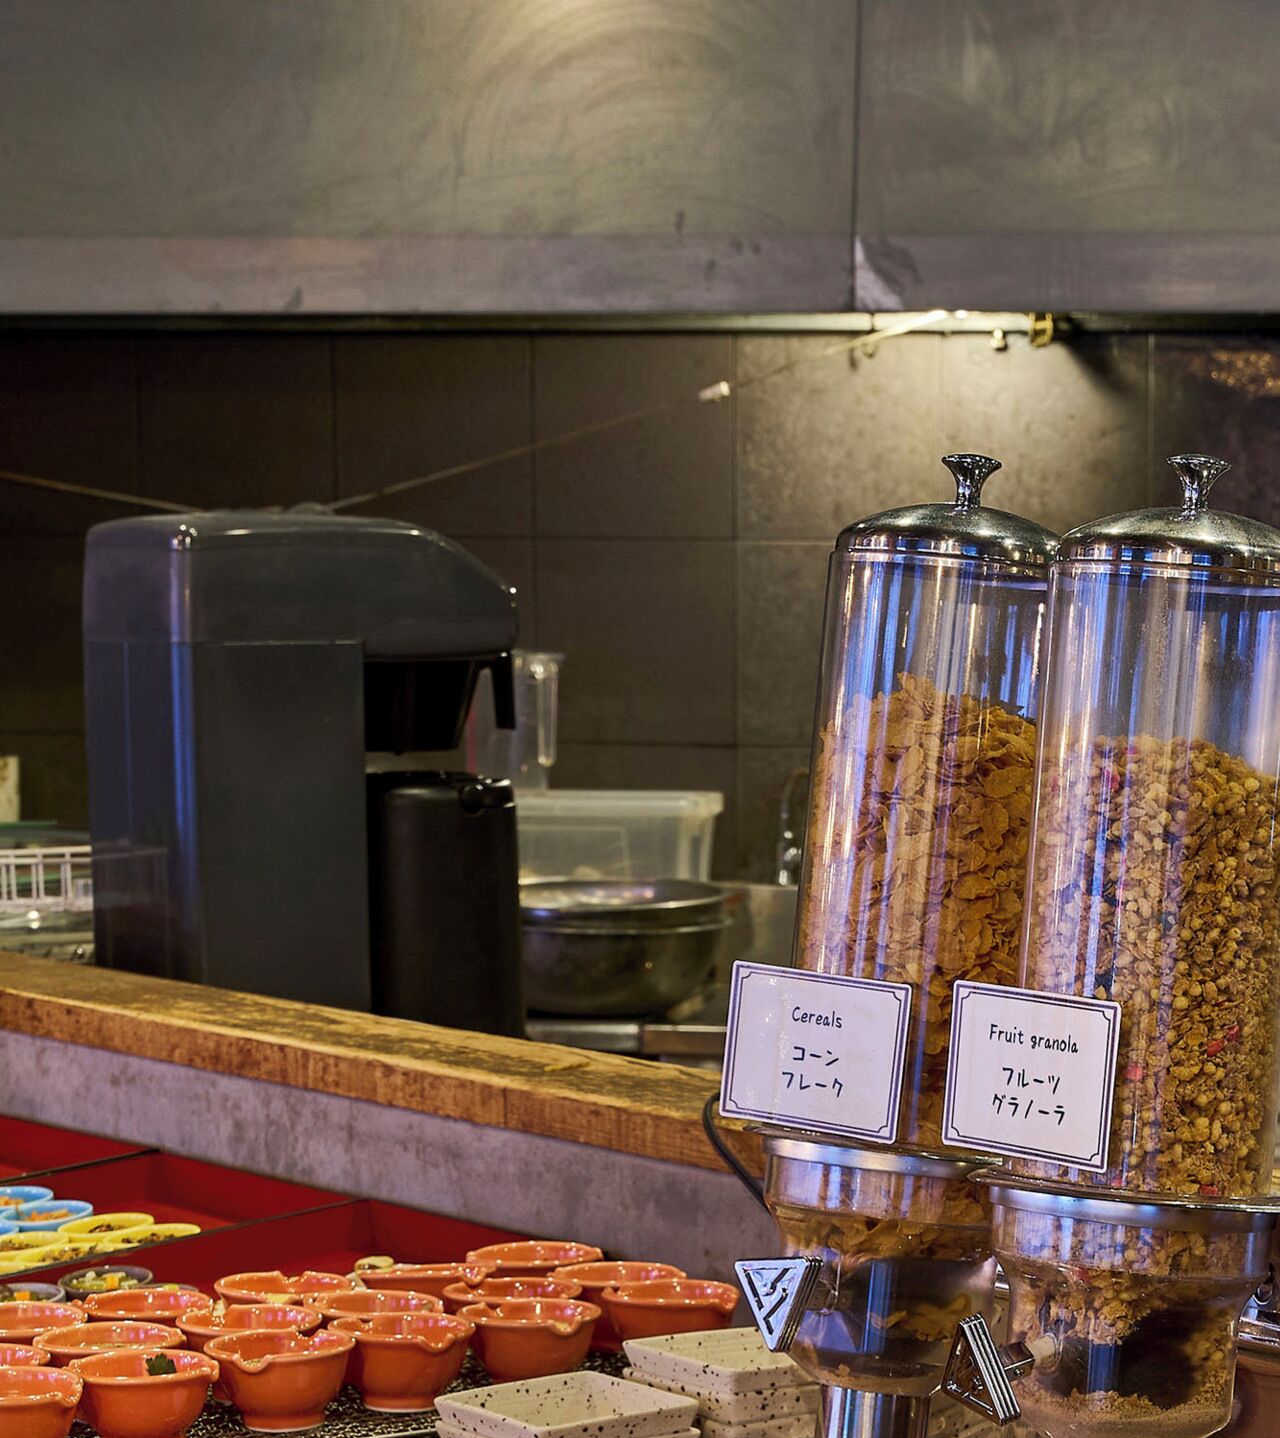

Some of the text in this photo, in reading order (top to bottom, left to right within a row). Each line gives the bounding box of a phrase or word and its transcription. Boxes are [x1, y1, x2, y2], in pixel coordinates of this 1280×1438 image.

[791, 1005, 843, 1029] Cereals
[988, 1023, 1079, 1054] Fruit granola
[792, 1045, 840, 1067] コーン
[781, 1071, 844, 1098] フレーク
[1001, 1067, 1061, 1096] フルーツ
[991, 1093, 1066, 1126] グラノーラ
